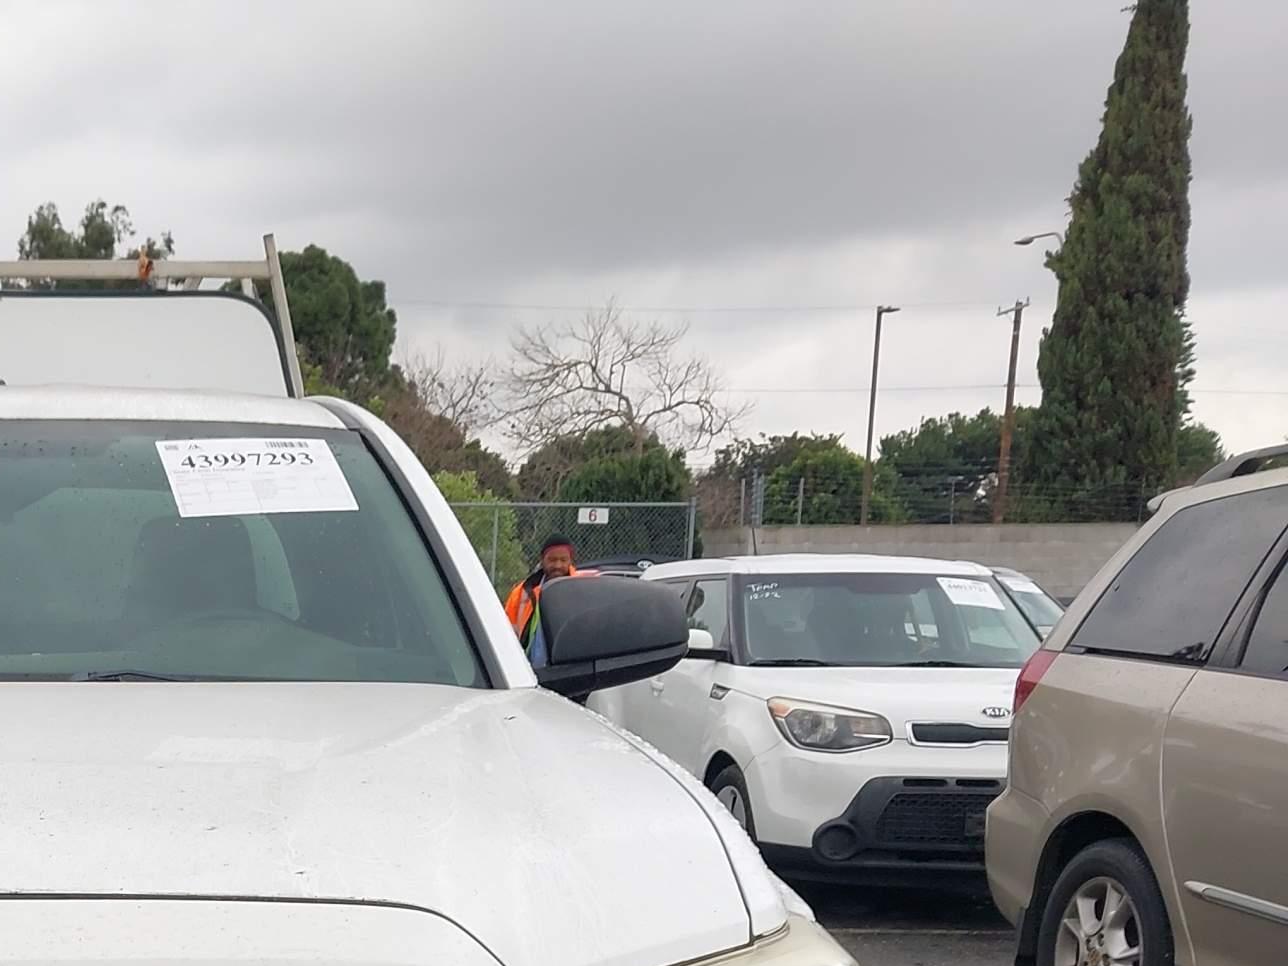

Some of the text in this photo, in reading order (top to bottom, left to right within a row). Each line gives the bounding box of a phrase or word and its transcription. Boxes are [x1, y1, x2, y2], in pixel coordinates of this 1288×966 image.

[180, 452, 314, 469] 43997293
[588, 509, 597, 522] 6
[983, 707, 1010, 717] KIA
